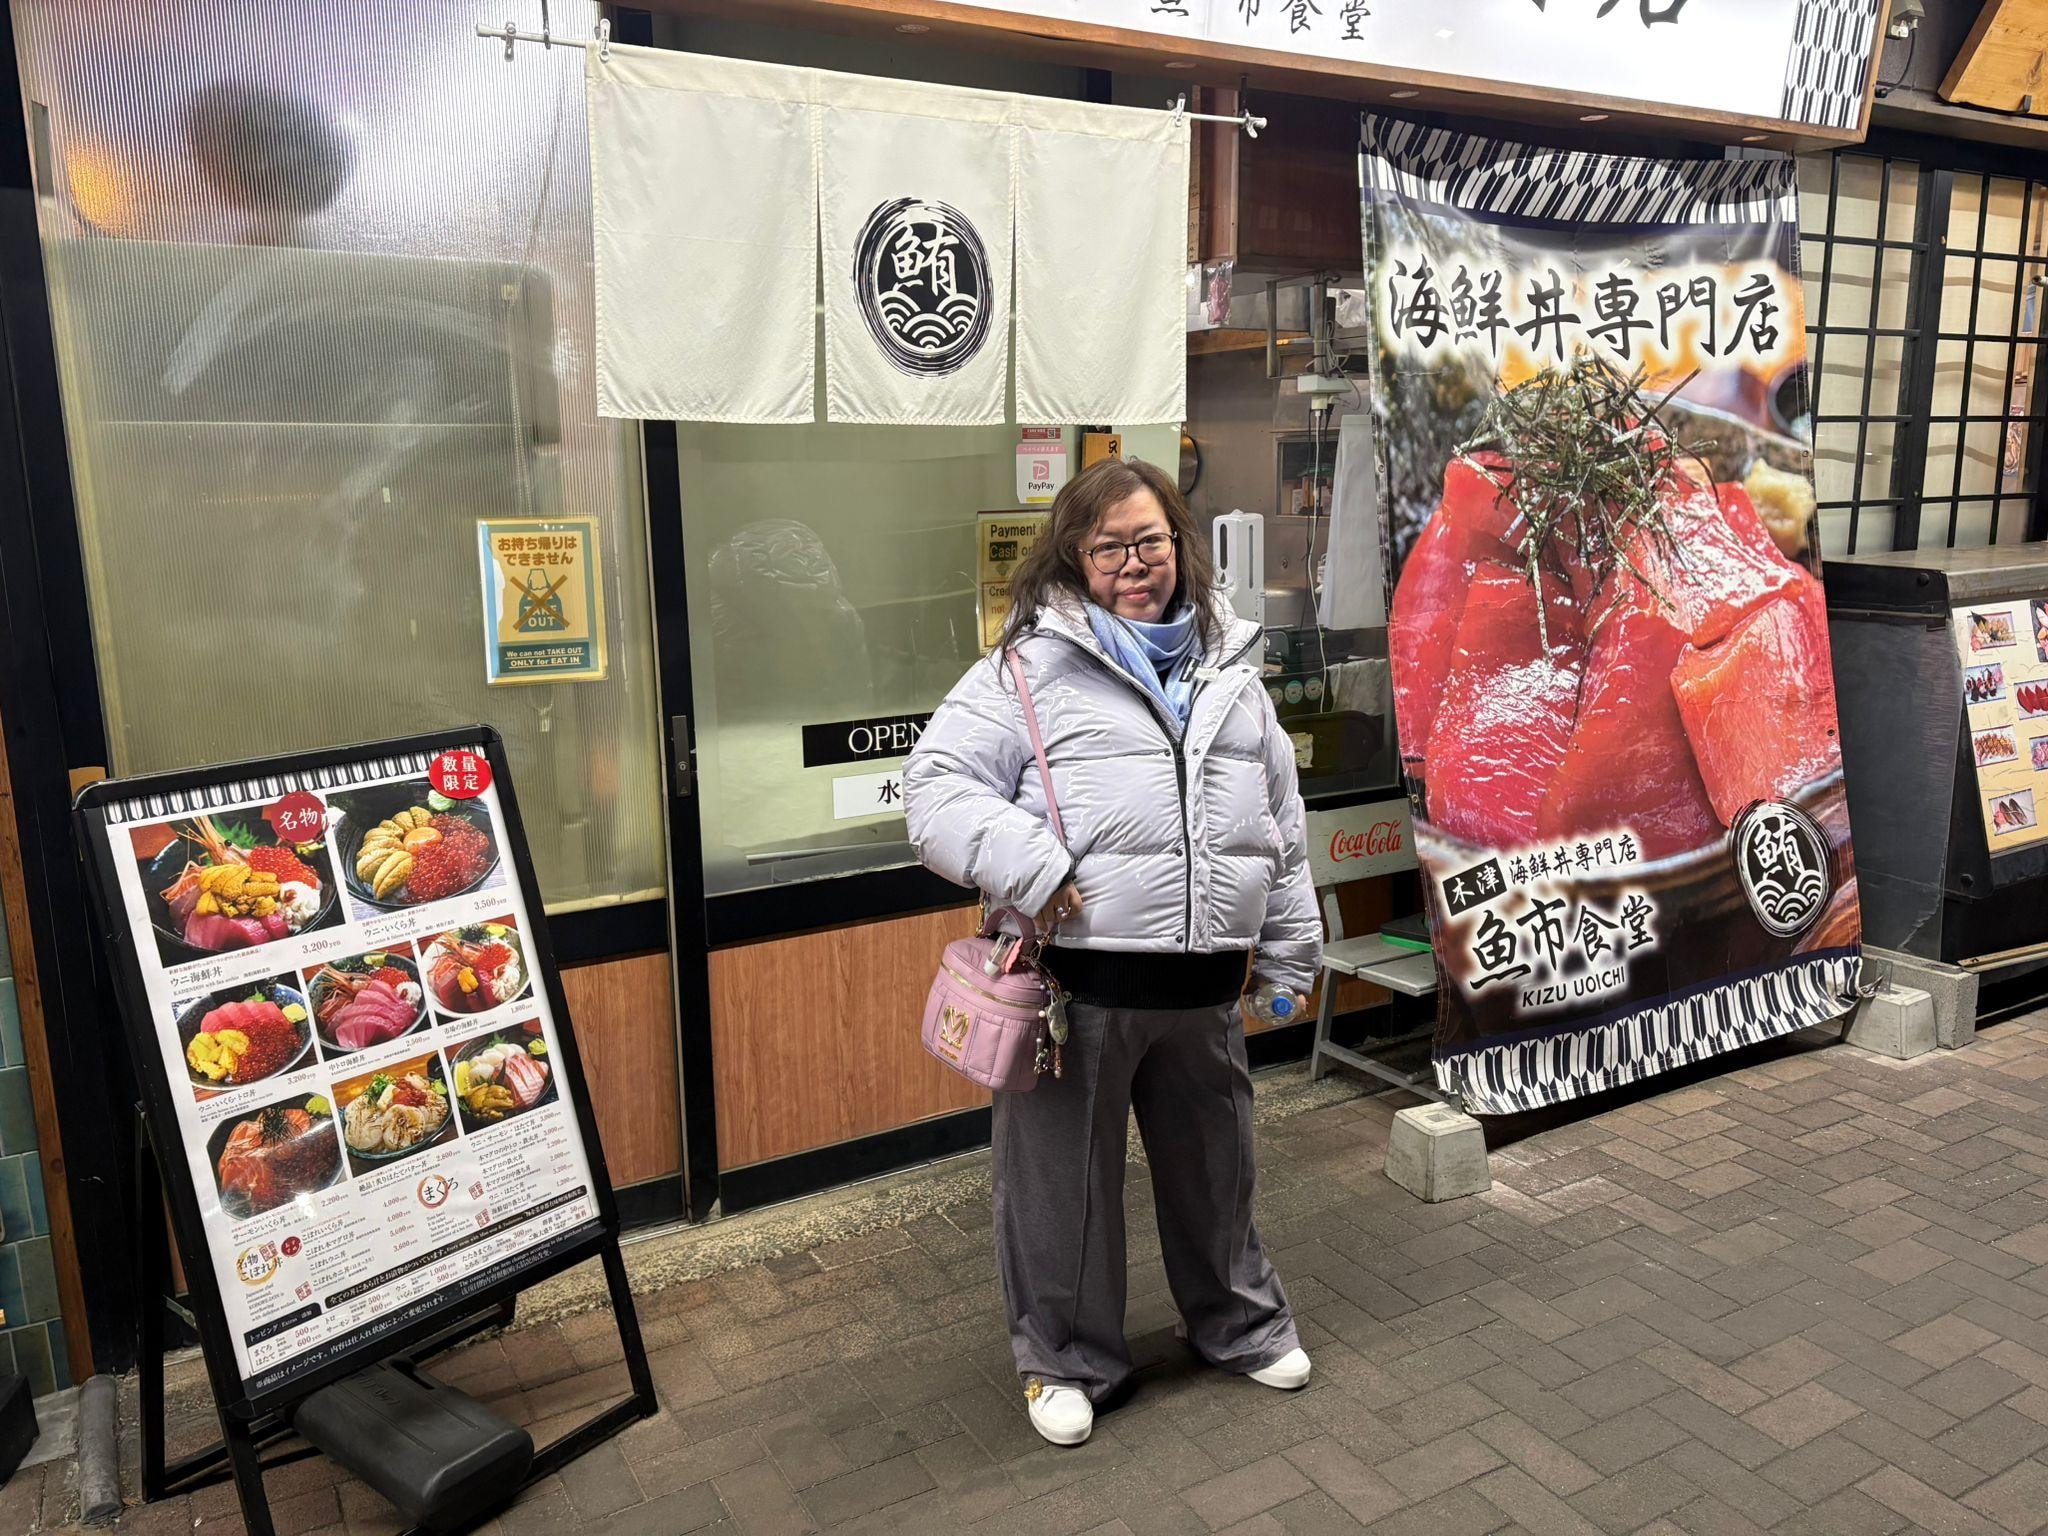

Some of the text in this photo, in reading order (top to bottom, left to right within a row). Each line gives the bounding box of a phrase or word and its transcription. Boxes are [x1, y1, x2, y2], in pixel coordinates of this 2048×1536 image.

[891, 223, 960, 296] 鮪
[1389, 254, 1780, 361] 海鮮丼専門店
[1028, 482, 1054, 491] PayPay
[991, 523, 1036, 538] Payment
[498, 536, 578, 552] お持ち帰りは
[990, 545, 1017, 559] Cash
[504, 551, 573, 567] できません
[528, 617, 555, 628] OUT
[507, 650, 519, 658] We
[510, 658, 534, 667] ONLY
[551, 656, 568, 664] EAT
[570, 656, 580, 664] IN
[441, 755, 477, 773] 数量
[443, 774, 480, 792] 限定
[279, 807, 318, 832] 名物
[1753, 818, 1805, 881] 鮪
[1449, 834, 1639, 907] 木津 海鮮丼専門店
[364, 917, 416, 938] ウニ・いくら丼
[1470, 894, 1655, 991] 魚市食堂
[170, 966, 223, 987] ウニ海鮮丼
[1522, 965, 1626, 1008] KIZU UOICHI
[232, 1216, 286, 1241] サーモンいくら丼
[249, 1324, 278, 1341] トッピング
[326, 1318, 350, 1332] サーモン
[253, 1343, 272, 1356] まぐろ
